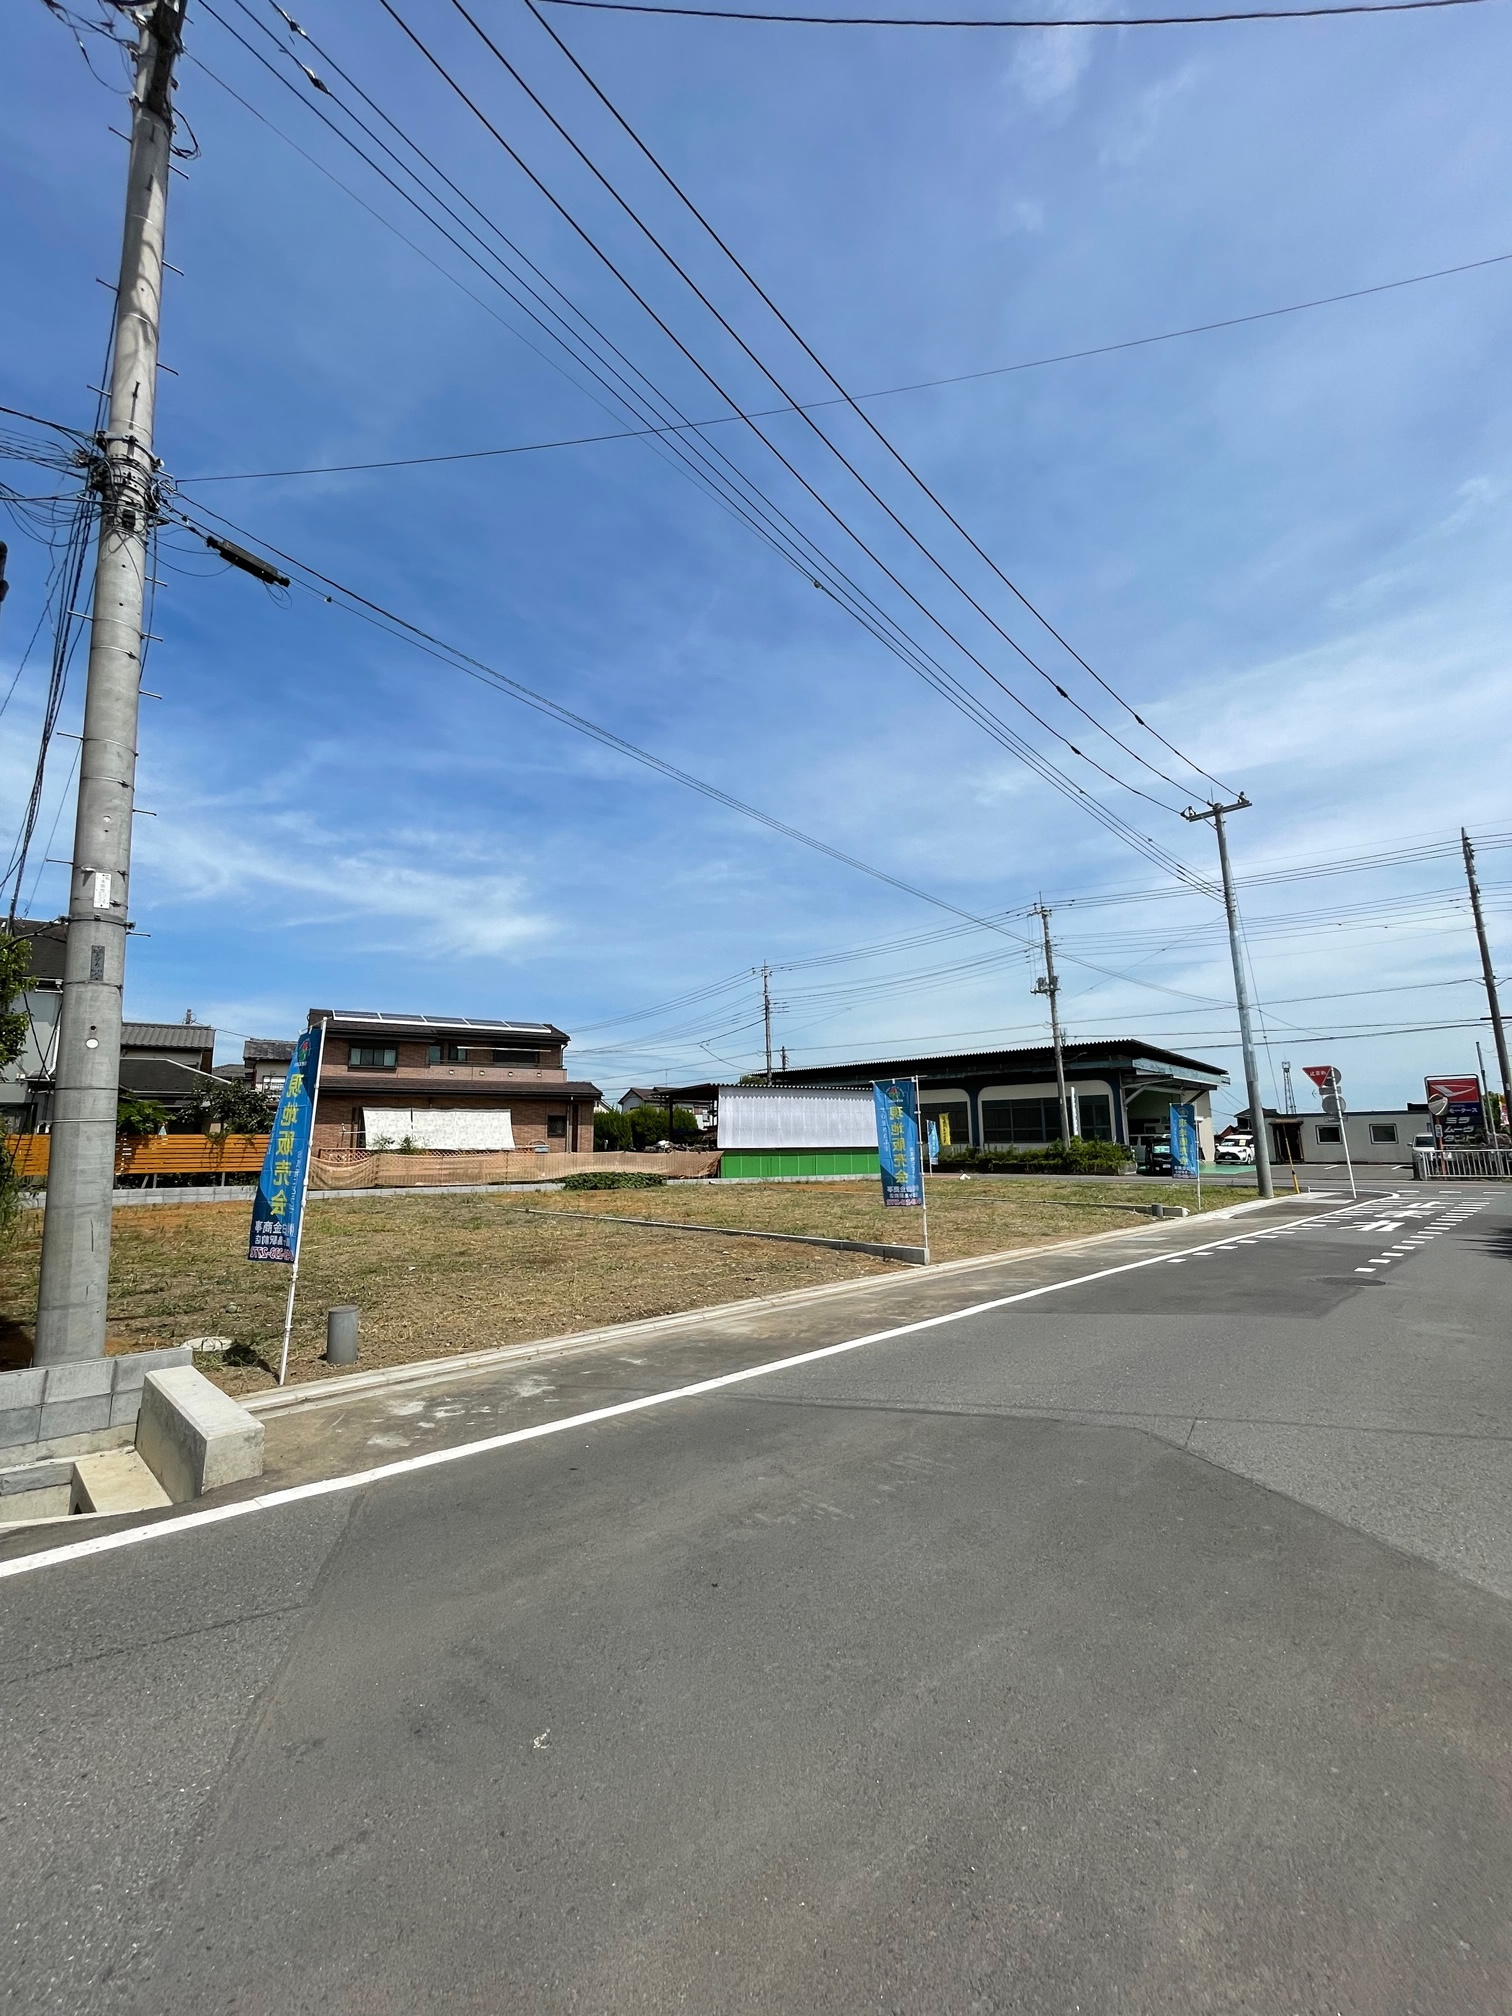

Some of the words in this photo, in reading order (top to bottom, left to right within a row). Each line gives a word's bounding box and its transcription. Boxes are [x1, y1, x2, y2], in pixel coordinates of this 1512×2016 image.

[1445, 1116, 1471, 1124] ミラ
[1443, 1134, 1476, 1143] タント
